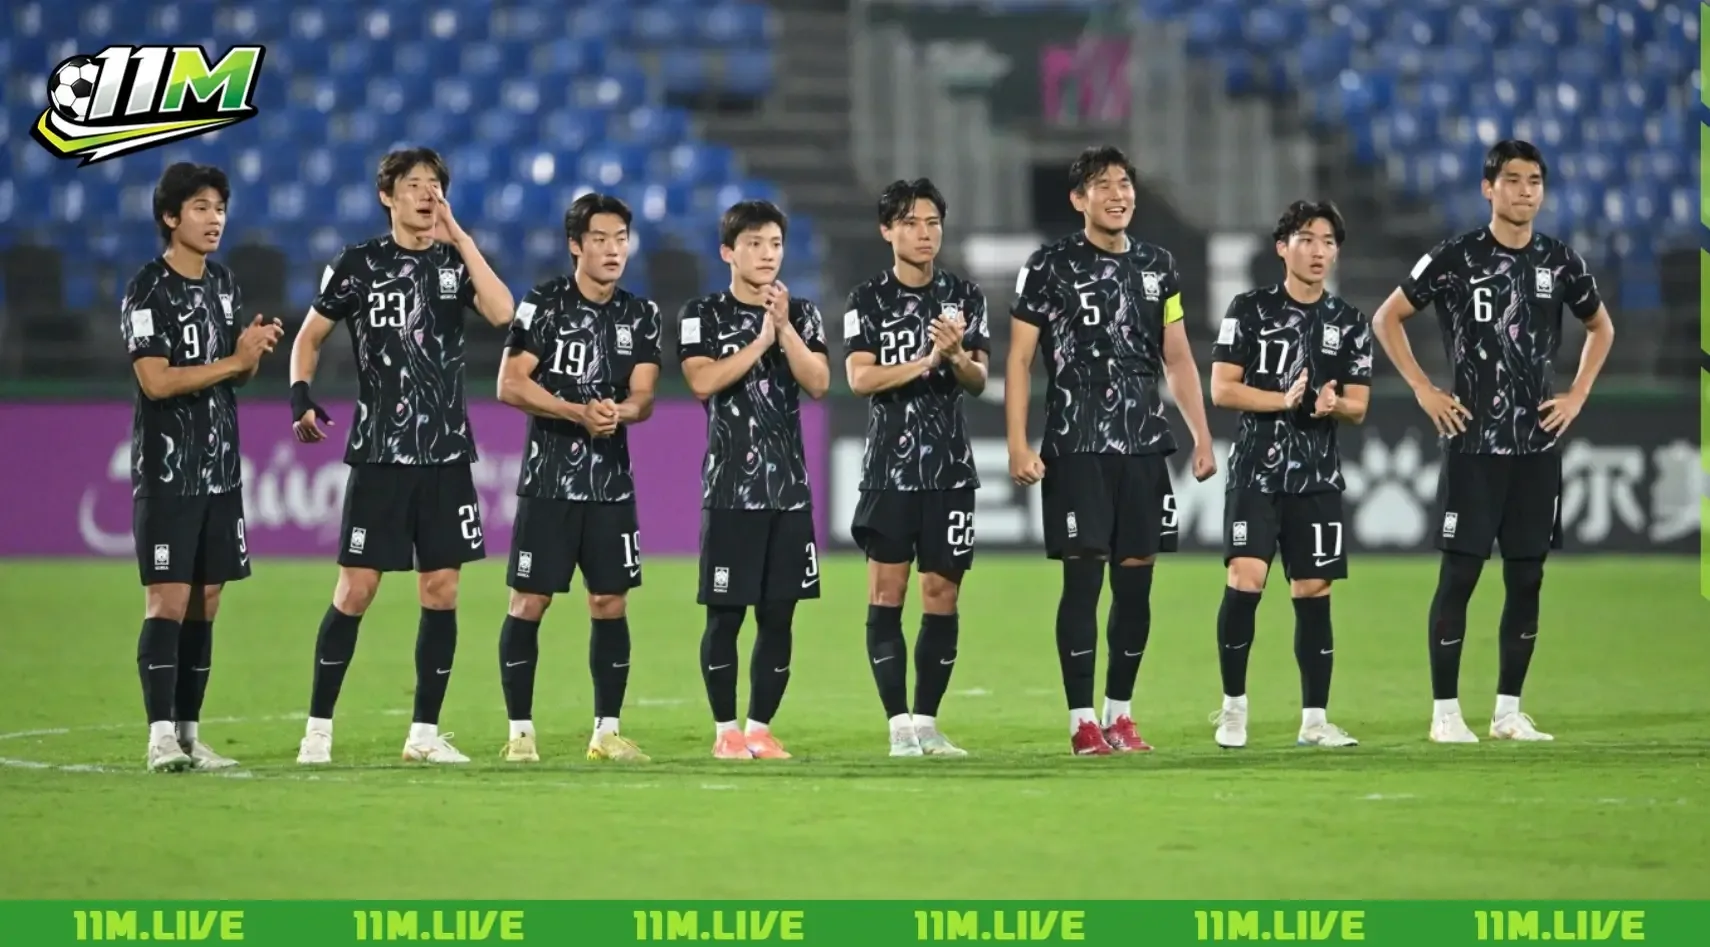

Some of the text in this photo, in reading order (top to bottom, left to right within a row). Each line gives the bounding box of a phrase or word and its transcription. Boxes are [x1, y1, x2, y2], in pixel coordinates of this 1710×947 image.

[367, 292, 406, 327] 23
[1080, 292, 1100, 325] 5
[1473, 287, 1492, 322] 6
[183, 323, 200, 360] 9
[549, 338, 586, 376] 19
[880, 330, 915, 366] 22
[1256, 339, 1290, 375] 17
[1311, 521, 1342, 557] 17
[805, 542, 818, 577] 3
